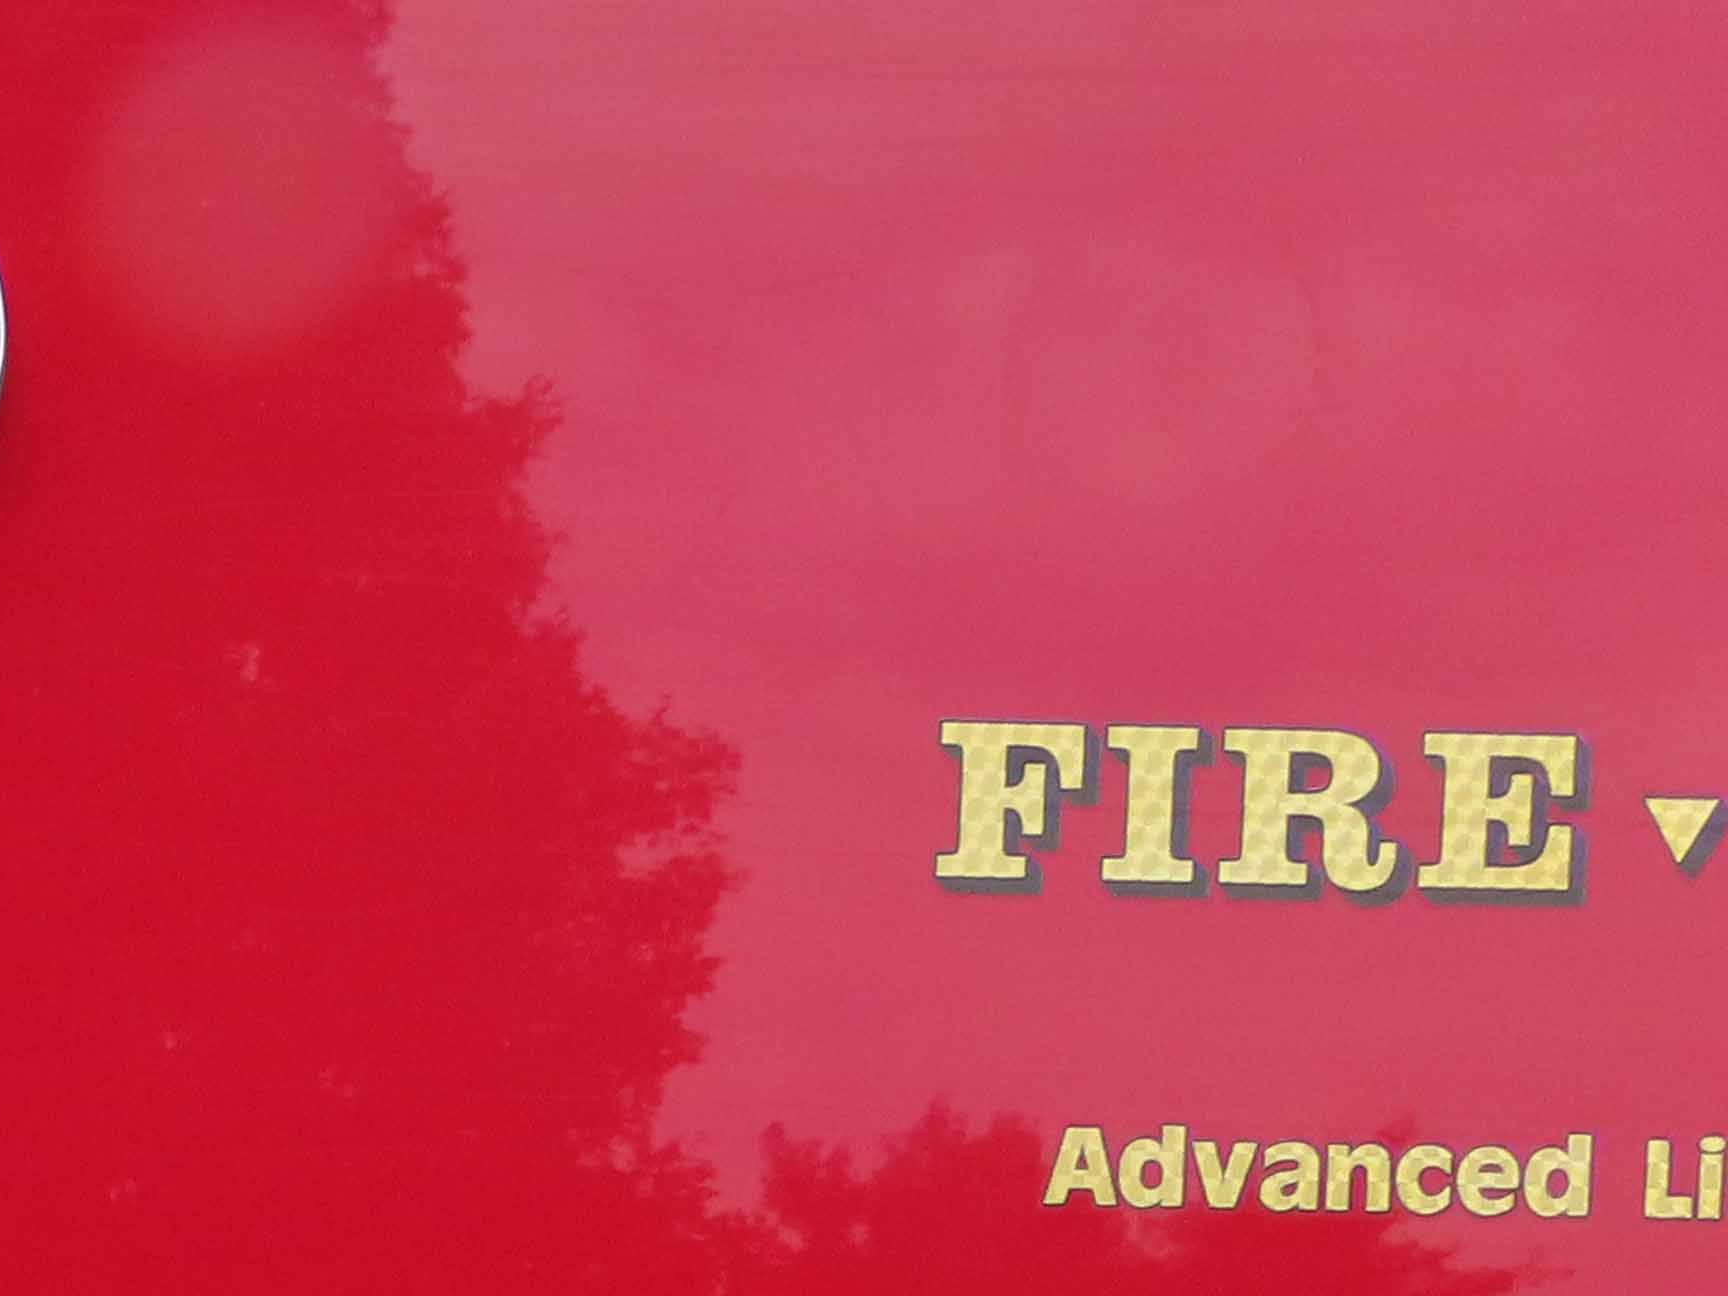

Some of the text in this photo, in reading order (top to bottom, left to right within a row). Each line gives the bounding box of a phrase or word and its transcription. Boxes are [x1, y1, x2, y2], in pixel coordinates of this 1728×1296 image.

[933, 718, 1586, 906] FIRE
[1043, 1125, 1725, 1220] Advanced Li
